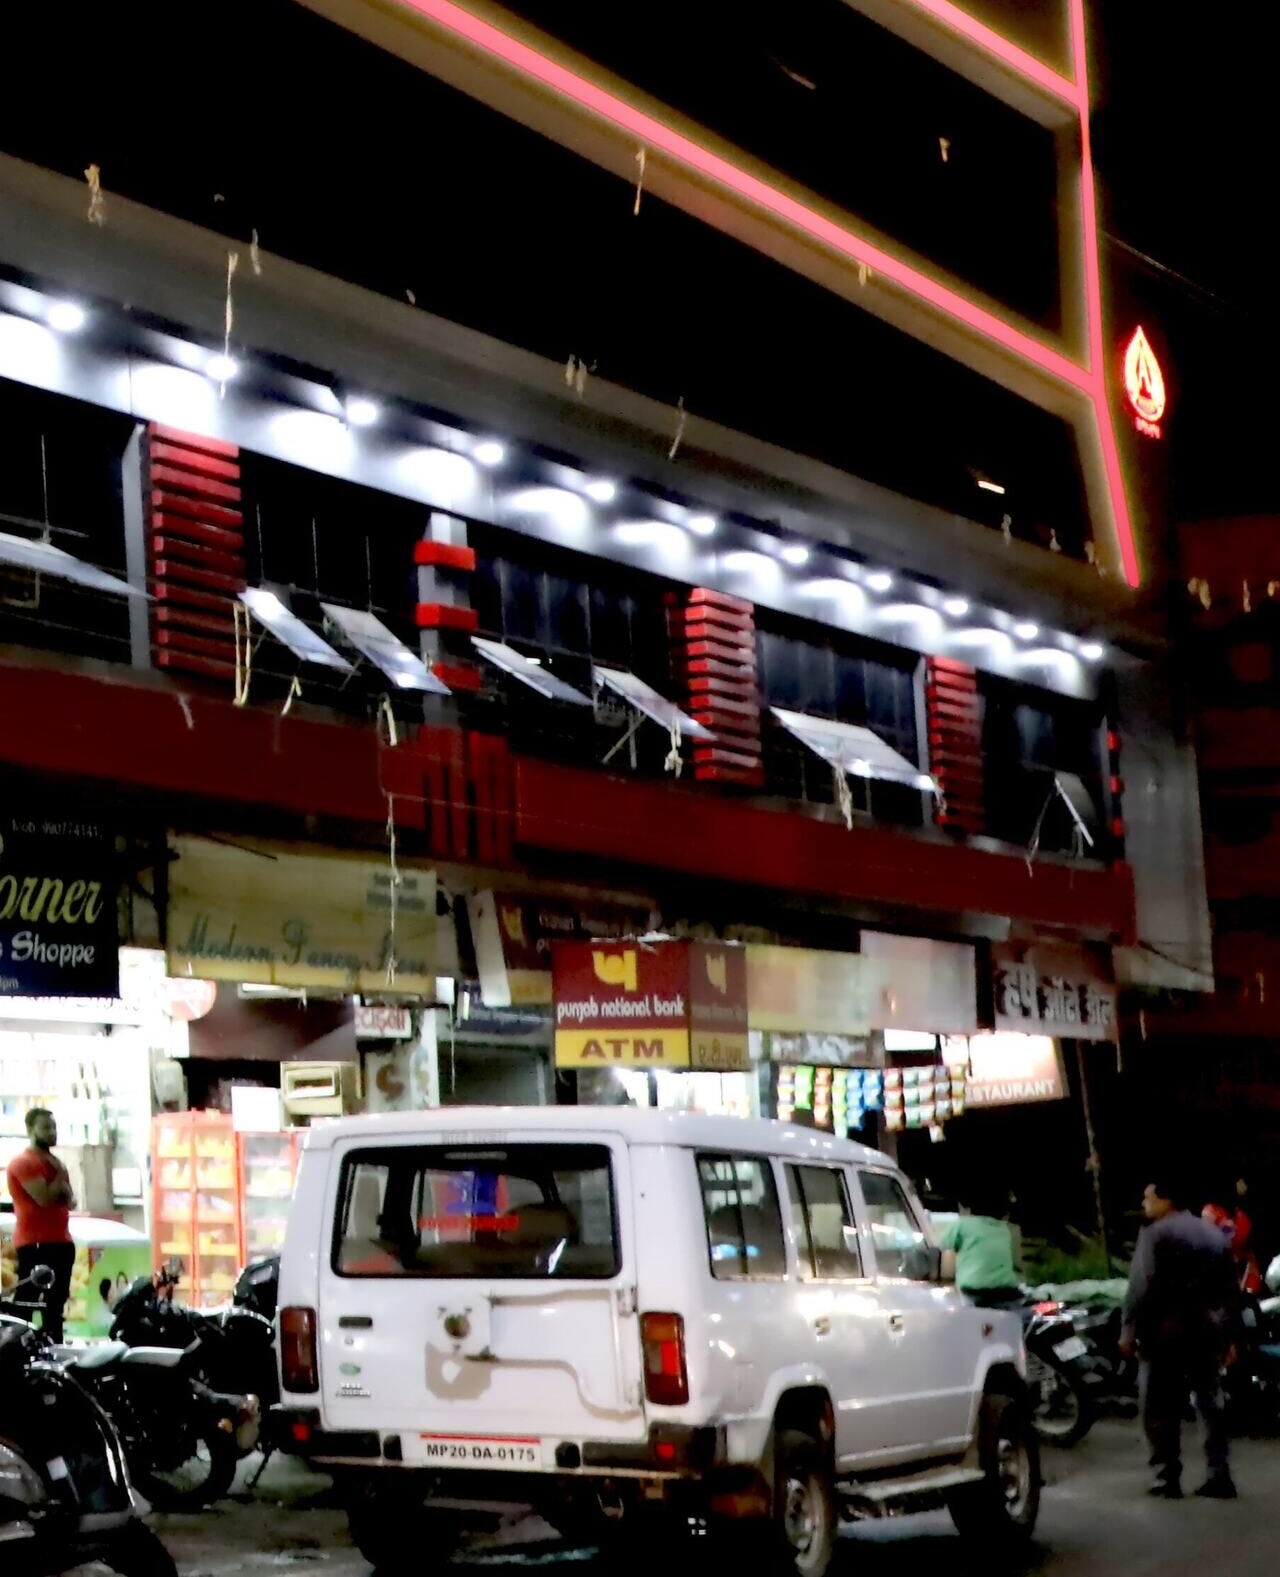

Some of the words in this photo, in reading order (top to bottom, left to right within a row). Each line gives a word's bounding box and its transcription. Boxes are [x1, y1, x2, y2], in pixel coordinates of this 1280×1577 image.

[10, 931, 96, 967] Shoppe
[557, 995, 599, 1024] punjab
[601, 995, 650, 1019] national
[653, 994, 684, 1018] bank
[580, 1037, 665, 1060] ATM
[966, 1079, 1056, 1103] ESTAURANT
